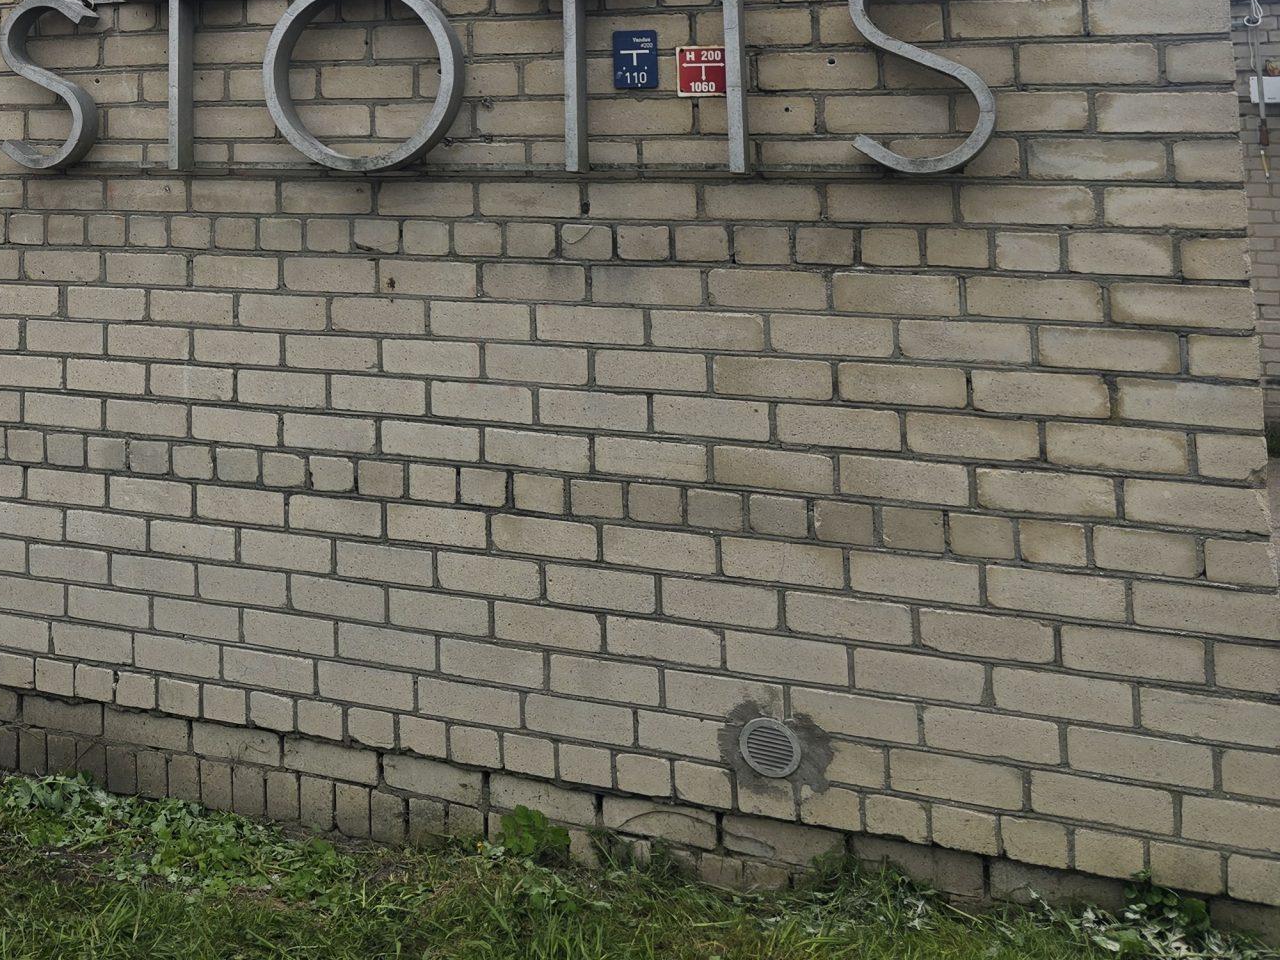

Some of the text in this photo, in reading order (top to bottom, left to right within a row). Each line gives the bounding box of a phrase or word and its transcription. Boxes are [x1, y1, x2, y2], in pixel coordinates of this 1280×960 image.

[686, 51, 721, 61] H 200
[625, 71, 647, 84] 110
[690, 82, 716, 92] 1060
